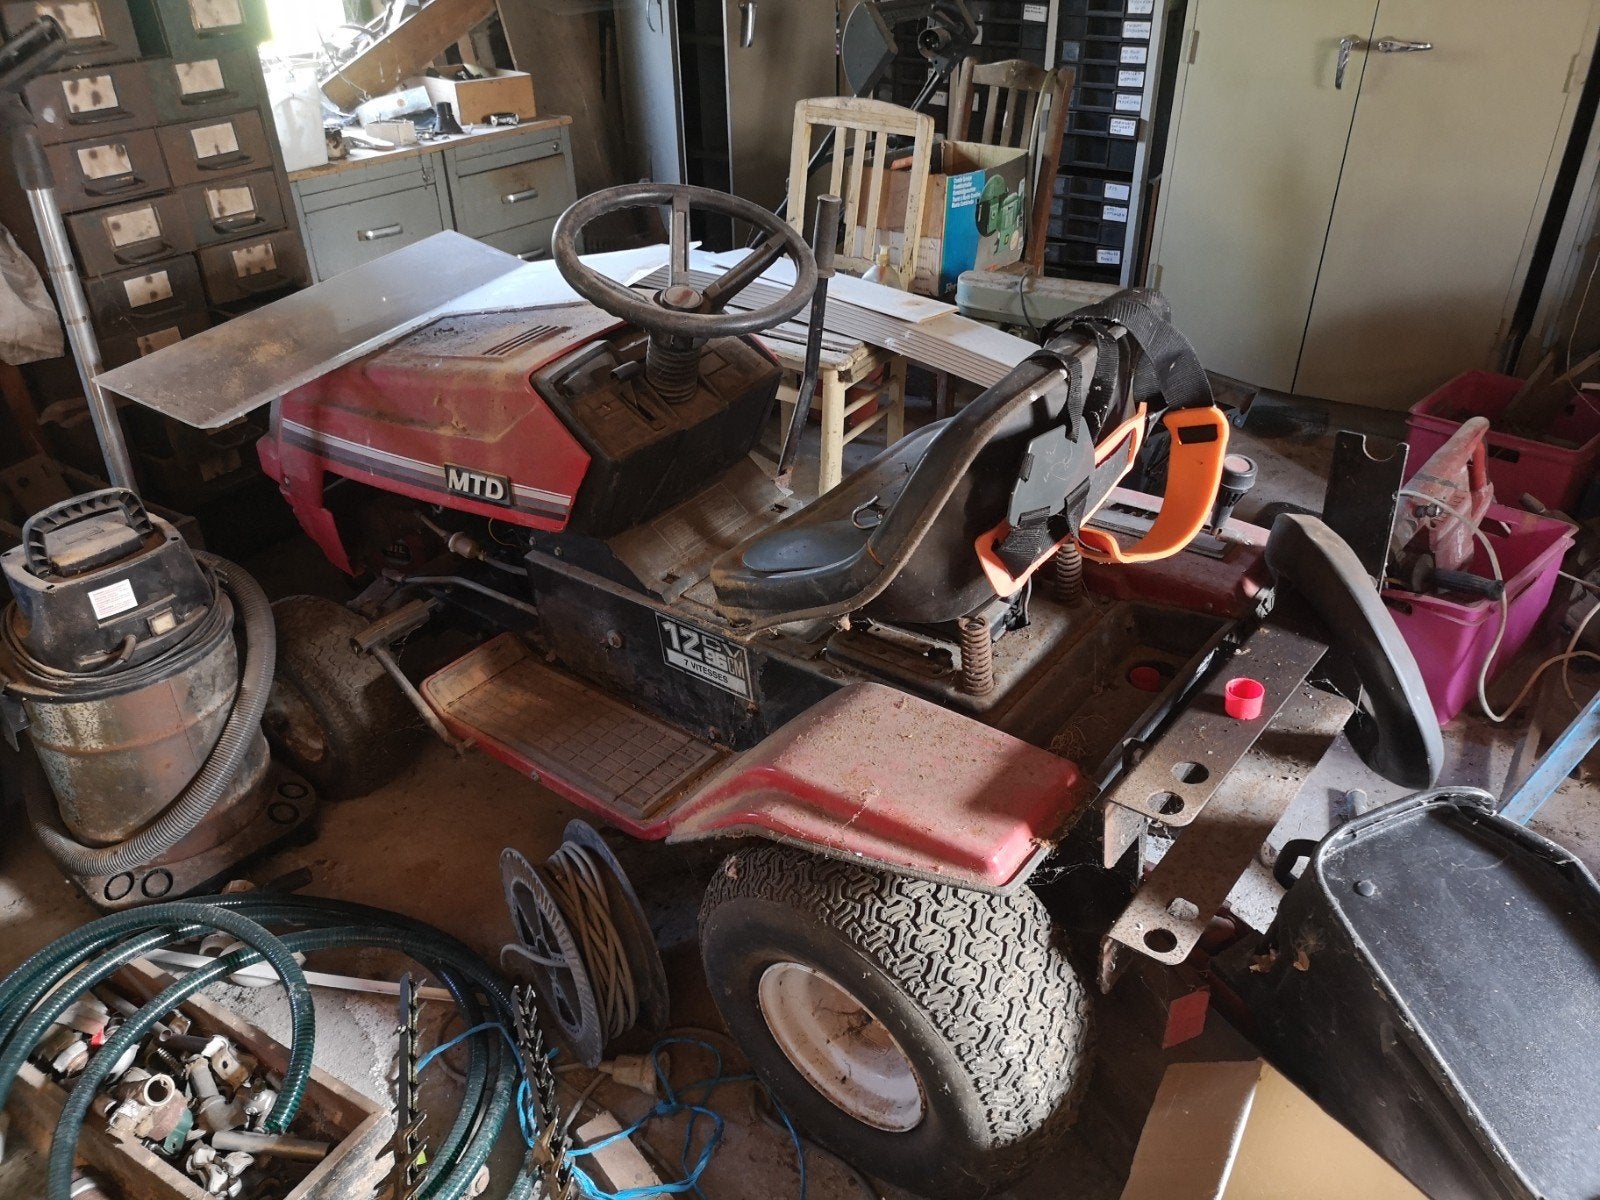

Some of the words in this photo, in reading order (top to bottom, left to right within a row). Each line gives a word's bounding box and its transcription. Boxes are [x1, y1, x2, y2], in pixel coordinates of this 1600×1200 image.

[448, 468, 504, 500] MTD
[661, 621, 703, 661] 12
[683, 658, 689, 667] 7
[690, 661, 729, 684] VITESSES
